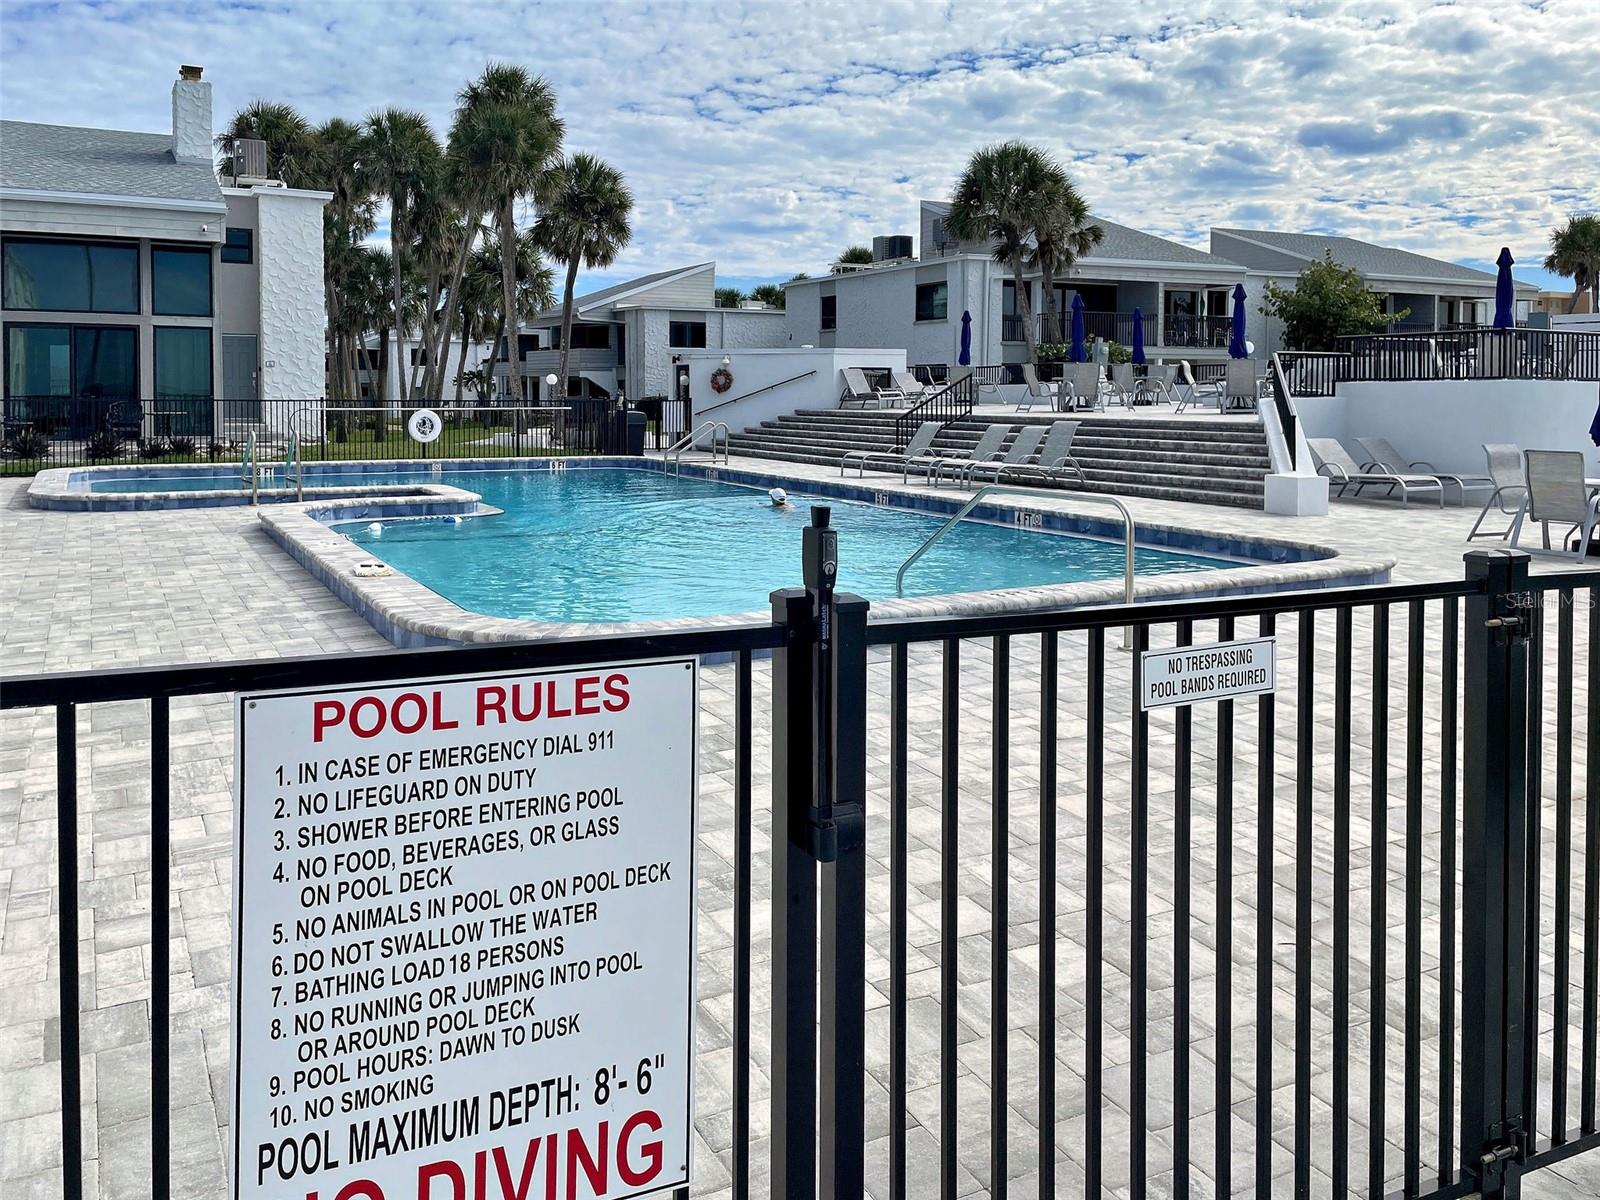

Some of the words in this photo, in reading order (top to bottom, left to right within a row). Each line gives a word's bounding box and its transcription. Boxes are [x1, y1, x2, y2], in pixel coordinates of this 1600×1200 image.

[264, 467, 273, 476] FT
[557, 461, 565, 469] FT
[1016, 511, 1021, 526] 4
[1024, 513, 1032, 528] FT
[1151, 680, 1178, 699] POOL
[1181, 675, 1214, 695] BANDS
[1217, 668, 1266, 690] REQUIRED
[1168, 657, 1182, 675] NO
[1185, 648, 1253, 672] TRESPASSING
[314, 691, 459, 743] POOL
[476, 674, 630, 726] RULES
[276, 765, 291, 786] 1.
[299, 762, 317, 784] IN
[325, 755, 380, 781] CASE
[387, 752, 413, 774] OF
[420, 738, 538, 770] EMERGENCY
[544, 734, 583, 756] DIAL
[588, 730, 613, 751] 911
[274, 798, 290, 819] 2.
[298, 793, 328, 816] NO
[335, 779, 448, 811] LIFEGUARD
[455, 774, 481, 796] ON
[488, 768, 536, 793] DUTY
[274, 830, 290, 851] 3.
[297, 817, 388, 848] SHOWER
[395, 806, 472, 835] BEFORE
[479, 793, 570, 824] ENTERING
[577, 787, 623, 811] POOL
[273, 862, 289, 883] 4.
[297, 856, 327, 880] NO
[334, 848, 395, 875] FOOD,
[403, 830, 523, 865] BEVERAGES,
[530, 825, 556, 846] OR
[562, 816, 619, 842] GLASS
[273, 923, 288, 945] 5.
[296, 917, 326, 941] NO
[331, 901, 421, 935] ANIMALS
[428, 897, 445, 919] IN
[452, 889, 503, 915] POOL
[509, 883, 536, 905] OR
[541, 878, 566, 900] ON
[573, 871, 620, 896] POOL
[625, 862, 671, 887] DECK
[301, 883, 330, 908] ON
[338, 876, 393, 903] POOL
[400, 865, 453, 893] DECK
[272, 955, 288, 977] 6.
[294, 949, 324, 974] DO
[332, 940, 375, 968] NOT
[381, 921, 484, 958] SWALLOW
[490, 913, 526, 938] THE
[532, 902, 597, 931] WATER
[271, 1019, 286, 1040] 8.
[295, 1011, 324, 1036] NO
[331, 992, 422, 1028] RUNNING
[429, 986, 456, 1009] OR
[462, 969, 544, 1003] JUMPING
[550, 960, 590, 986] INTO
[596, 951, 642, 977] POOL
[272, 986, 287, 1008] 7.
[295, 968, 384, 1004] BATHING
[392, 957, 445, 986] LOAD
[449, 952, 470, 974] 18
[478, 936, 564, 970] PERSONS
[270, 1076, 286, 1097] 9.
[294, 1062, 350, 1093] POOL
[358, 1046, 432, 1079] HOURS:
[440, 1031, 495, 1062] DAWN
[501, 1025, 525, 1048] TO
[532, 1013, 580, 1042] DUSK
[298, 1038, 328, 1062] OR
[333, 1020, 419, 1056] AROUND
[427, 1009, 478, 1037] POOL
[485, 996, 535, 1025] DECK
[258, 1130, 339, 1186] POOL
[349, 1096, 479, 1165] MAXIMUM
[489, 1075, 579, 1131] DEPTH:
[270, 1105, 297, 1128] 10.
[305, 1096, 334, 1121] NO
[341, 1074, 433, 1113] SMOKING
